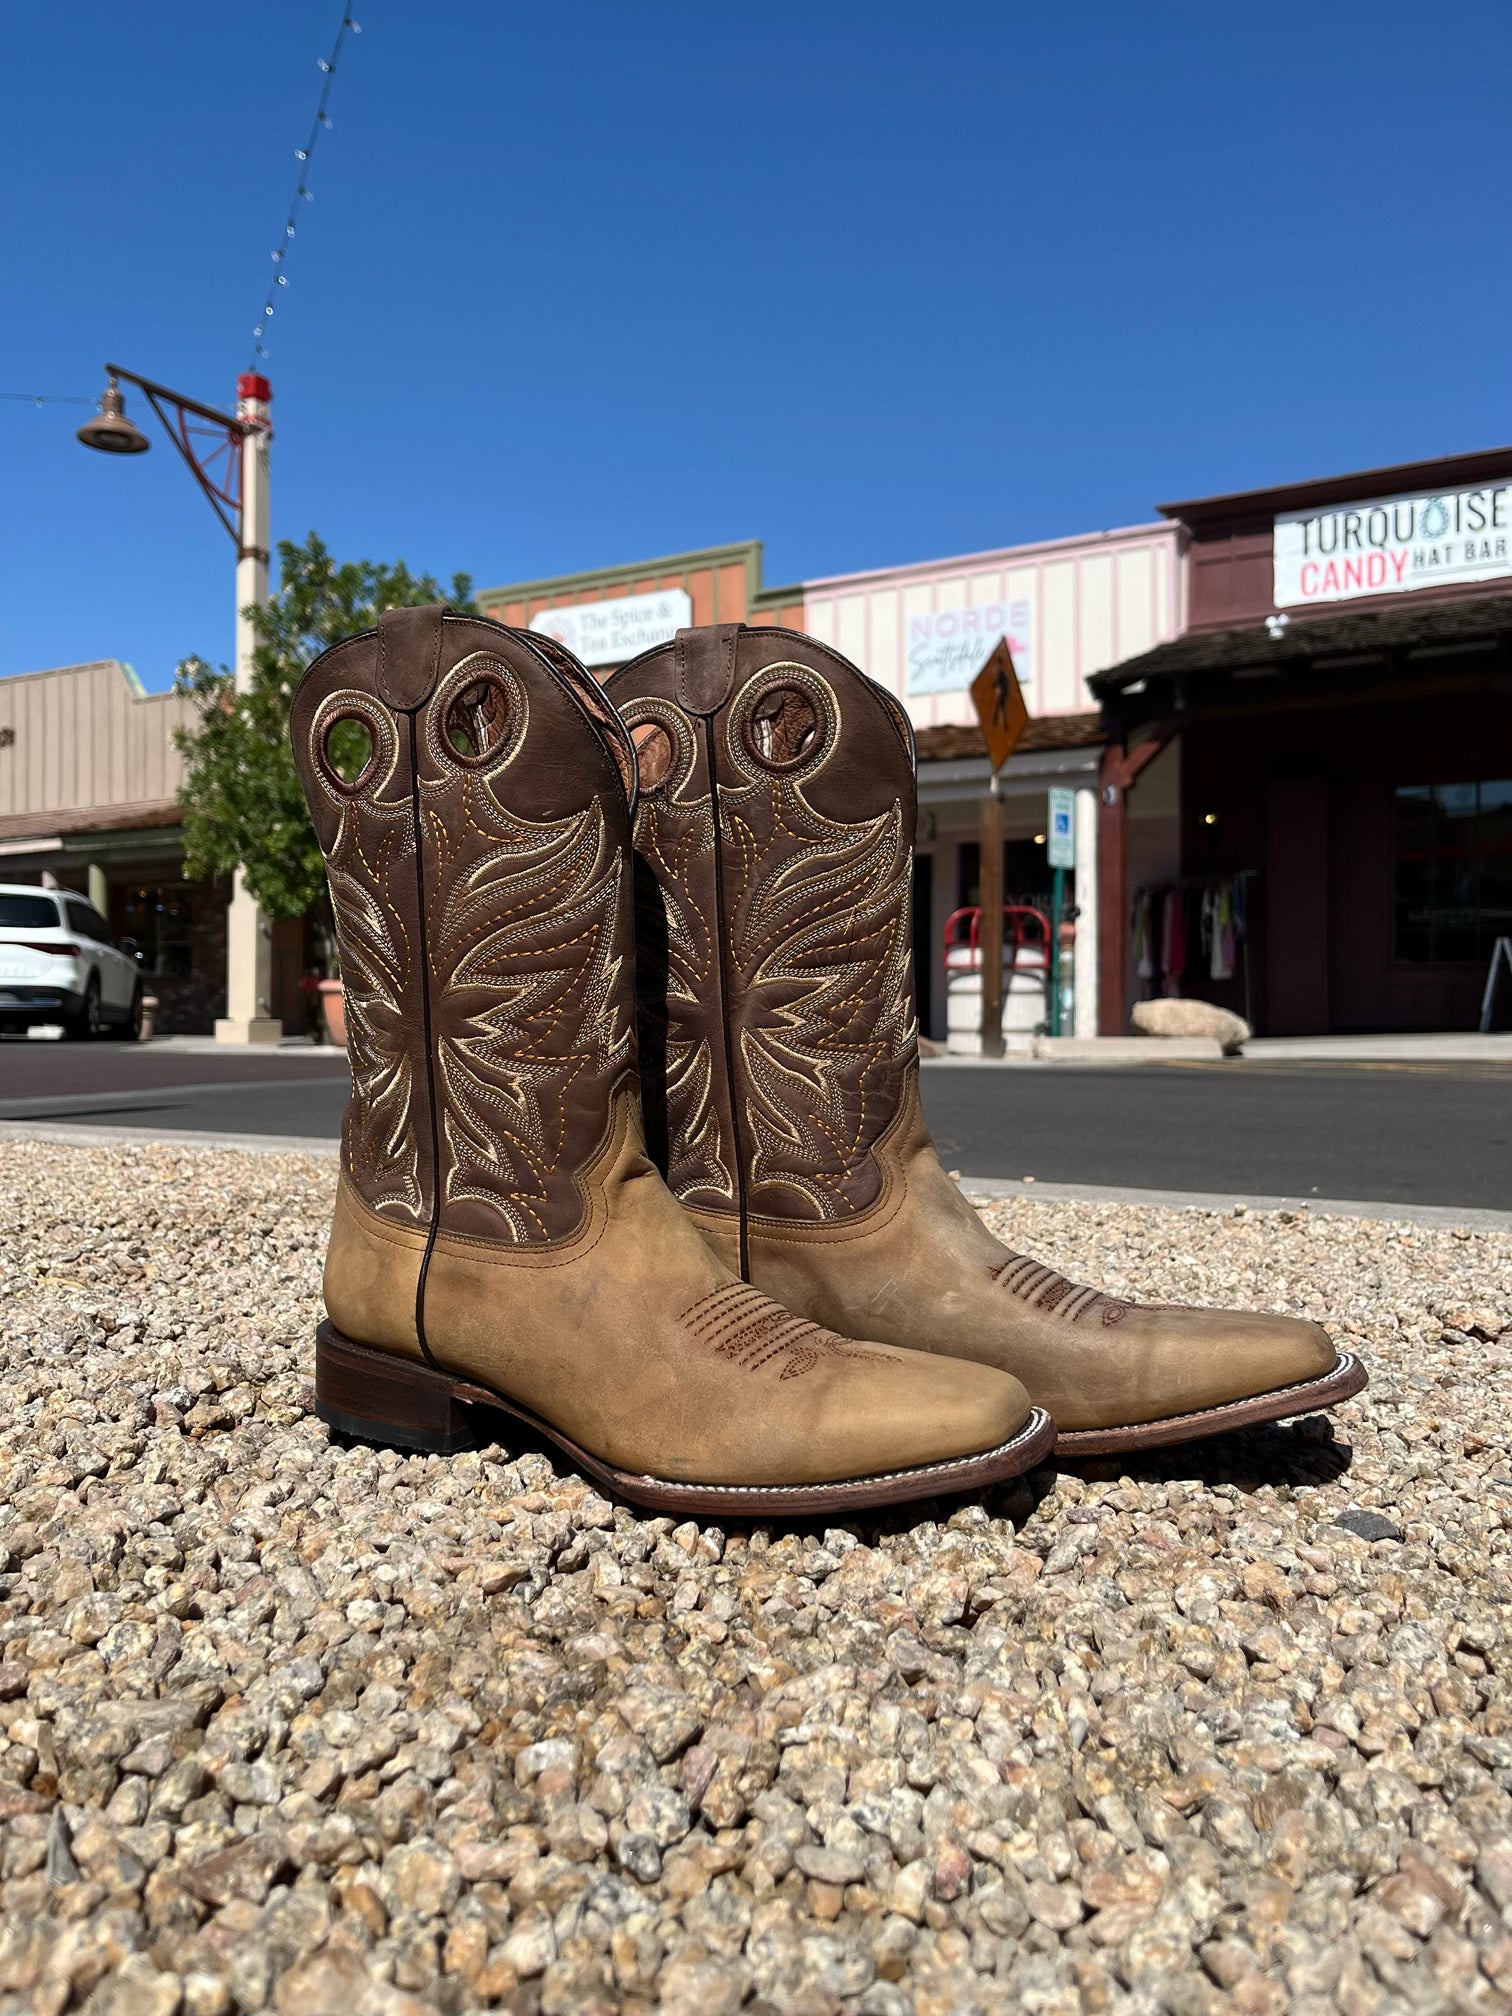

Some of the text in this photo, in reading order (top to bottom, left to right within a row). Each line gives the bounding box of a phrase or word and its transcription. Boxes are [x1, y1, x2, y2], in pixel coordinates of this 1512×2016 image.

[1300, 547, 1410, 597] CANDY
[1412, 537, 1508, 570] HAT BAR
[580, 600, 673, 631] The Spice &
[911, 599, 1030, 641] NORDE
